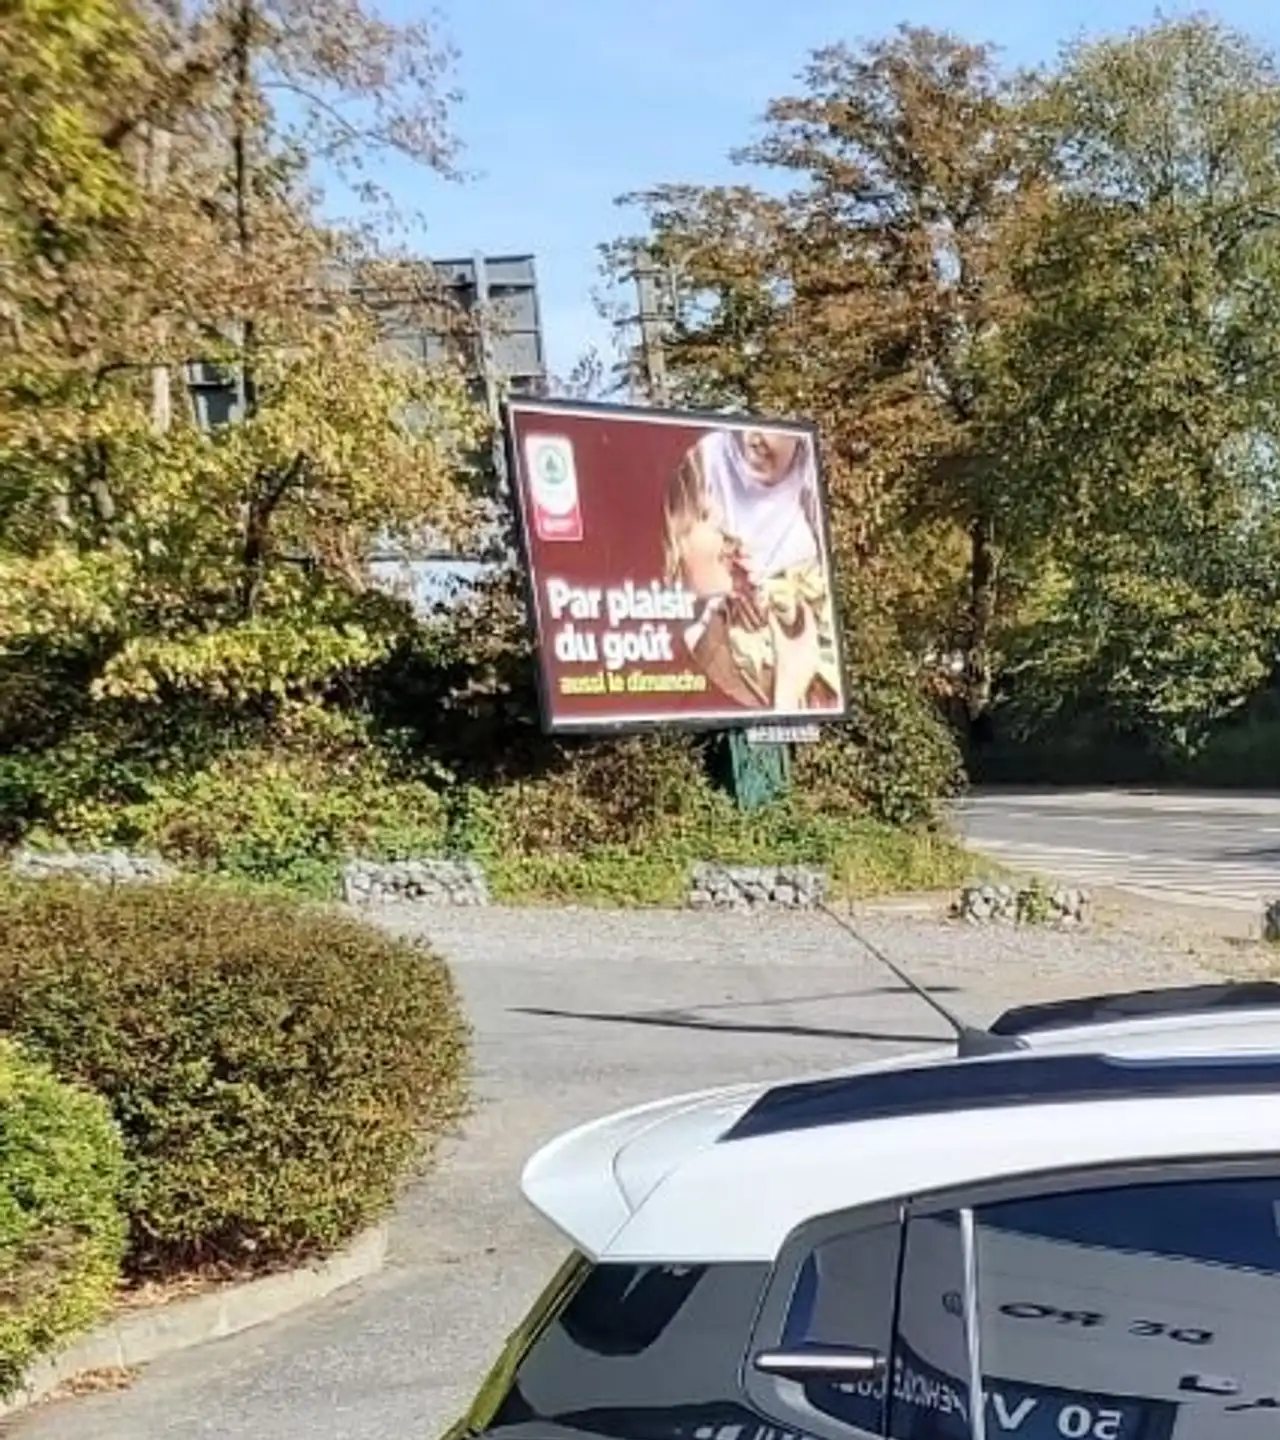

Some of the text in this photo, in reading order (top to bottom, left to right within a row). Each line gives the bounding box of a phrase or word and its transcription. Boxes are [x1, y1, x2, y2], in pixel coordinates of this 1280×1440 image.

[546, 579, 697, 627] Par plaisir
[555, 623, 673, 670] du goût
